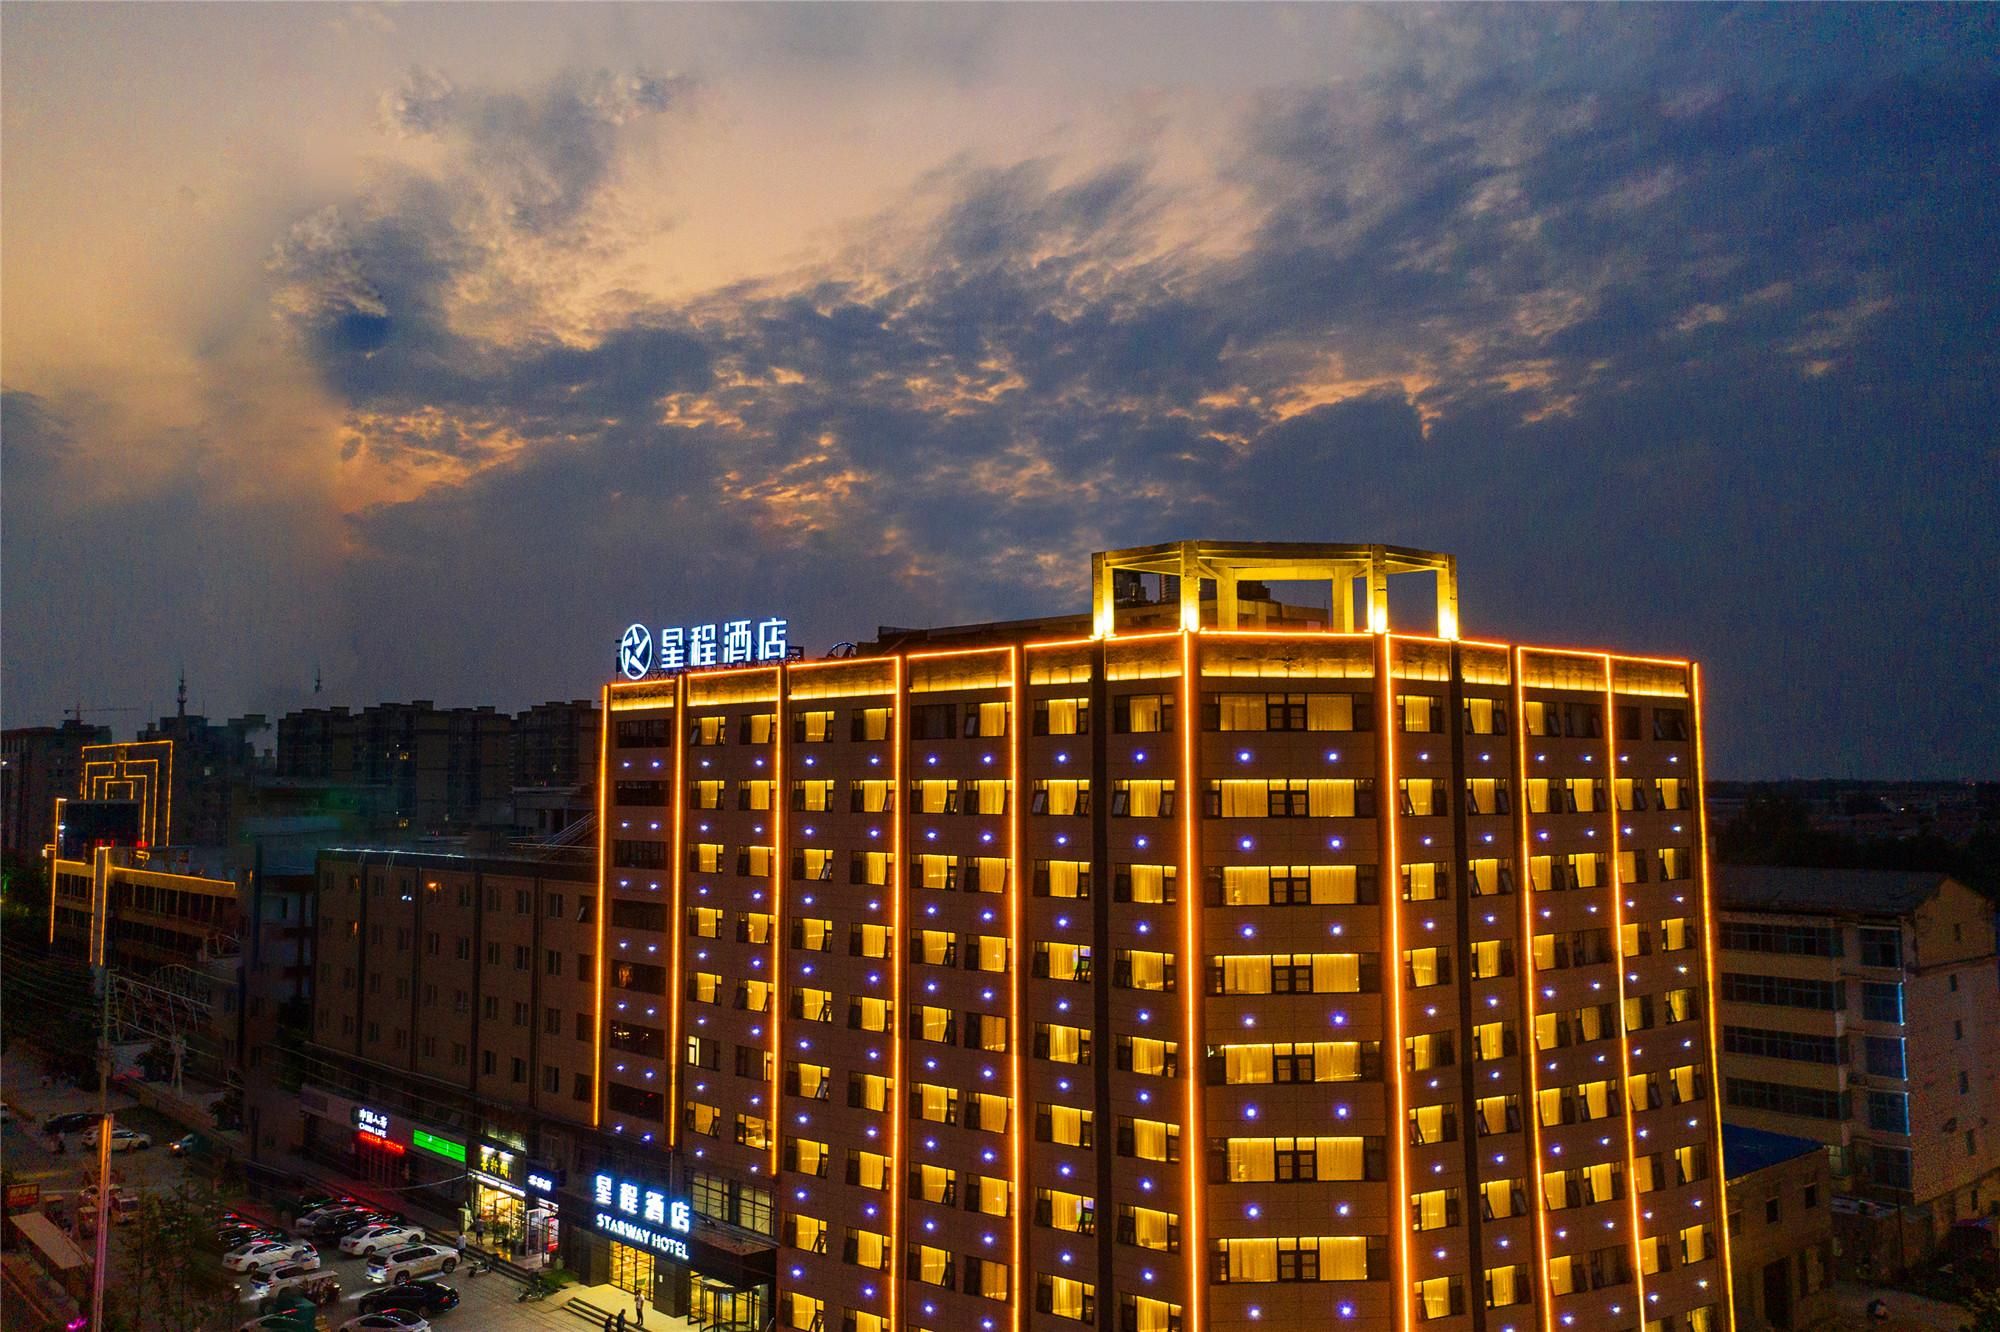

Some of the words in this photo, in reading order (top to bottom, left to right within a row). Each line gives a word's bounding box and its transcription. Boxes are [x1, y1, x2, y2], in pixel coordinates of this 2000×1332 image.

[661, 617, 788, 669] 星程酒店
[375, 1128, 387, 1138] LIFE
[595, 1174, 690, 1233] 星程酒店
[596, 1213, 651, 1244] STARWAY
[652, 1233, 690, 1260] HOTEL
